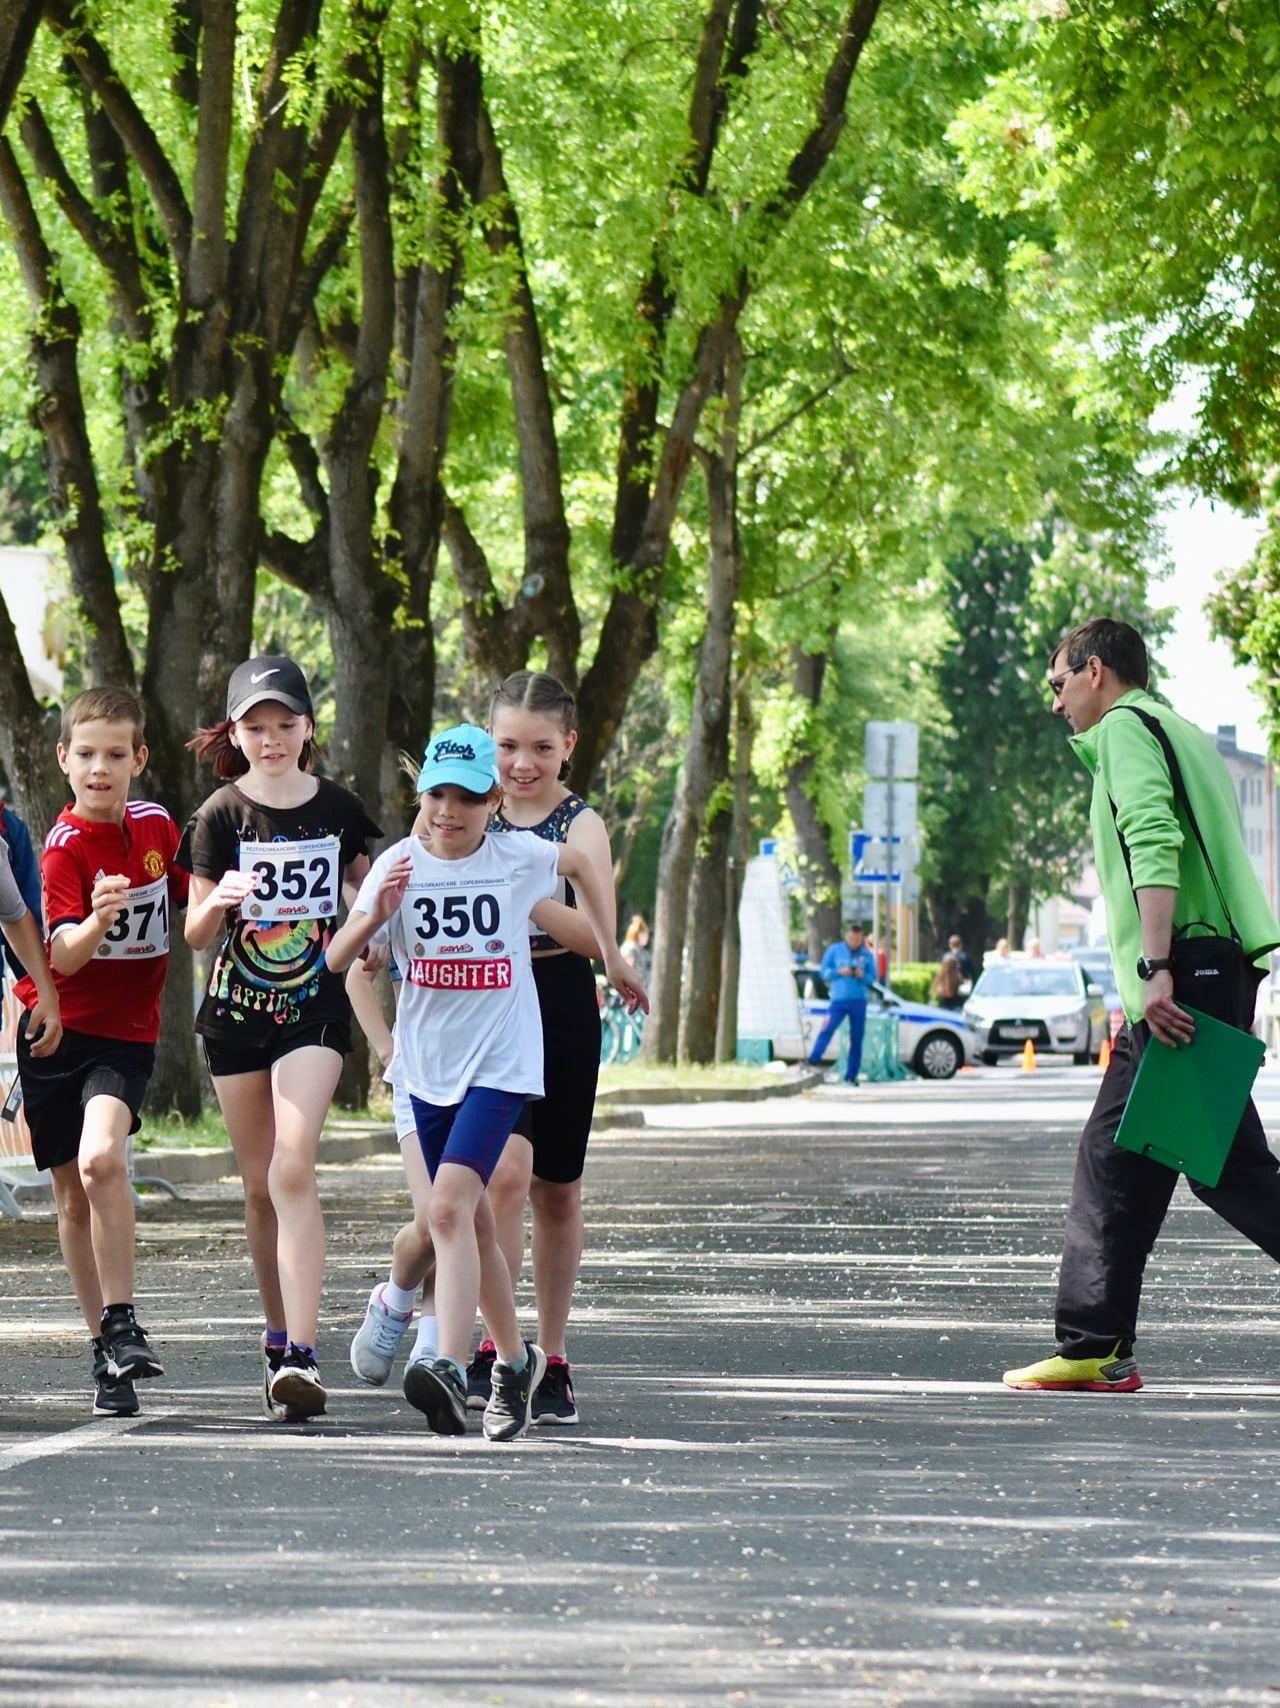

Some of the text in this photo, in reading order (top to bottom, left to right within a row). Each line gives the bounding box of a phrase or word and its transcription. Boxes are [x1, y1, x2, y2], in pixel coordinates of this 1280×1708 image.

[252, 857, 331, 901] 352
[104, 895, 168, 942] 371
[413, 893, 500, 940] 350
